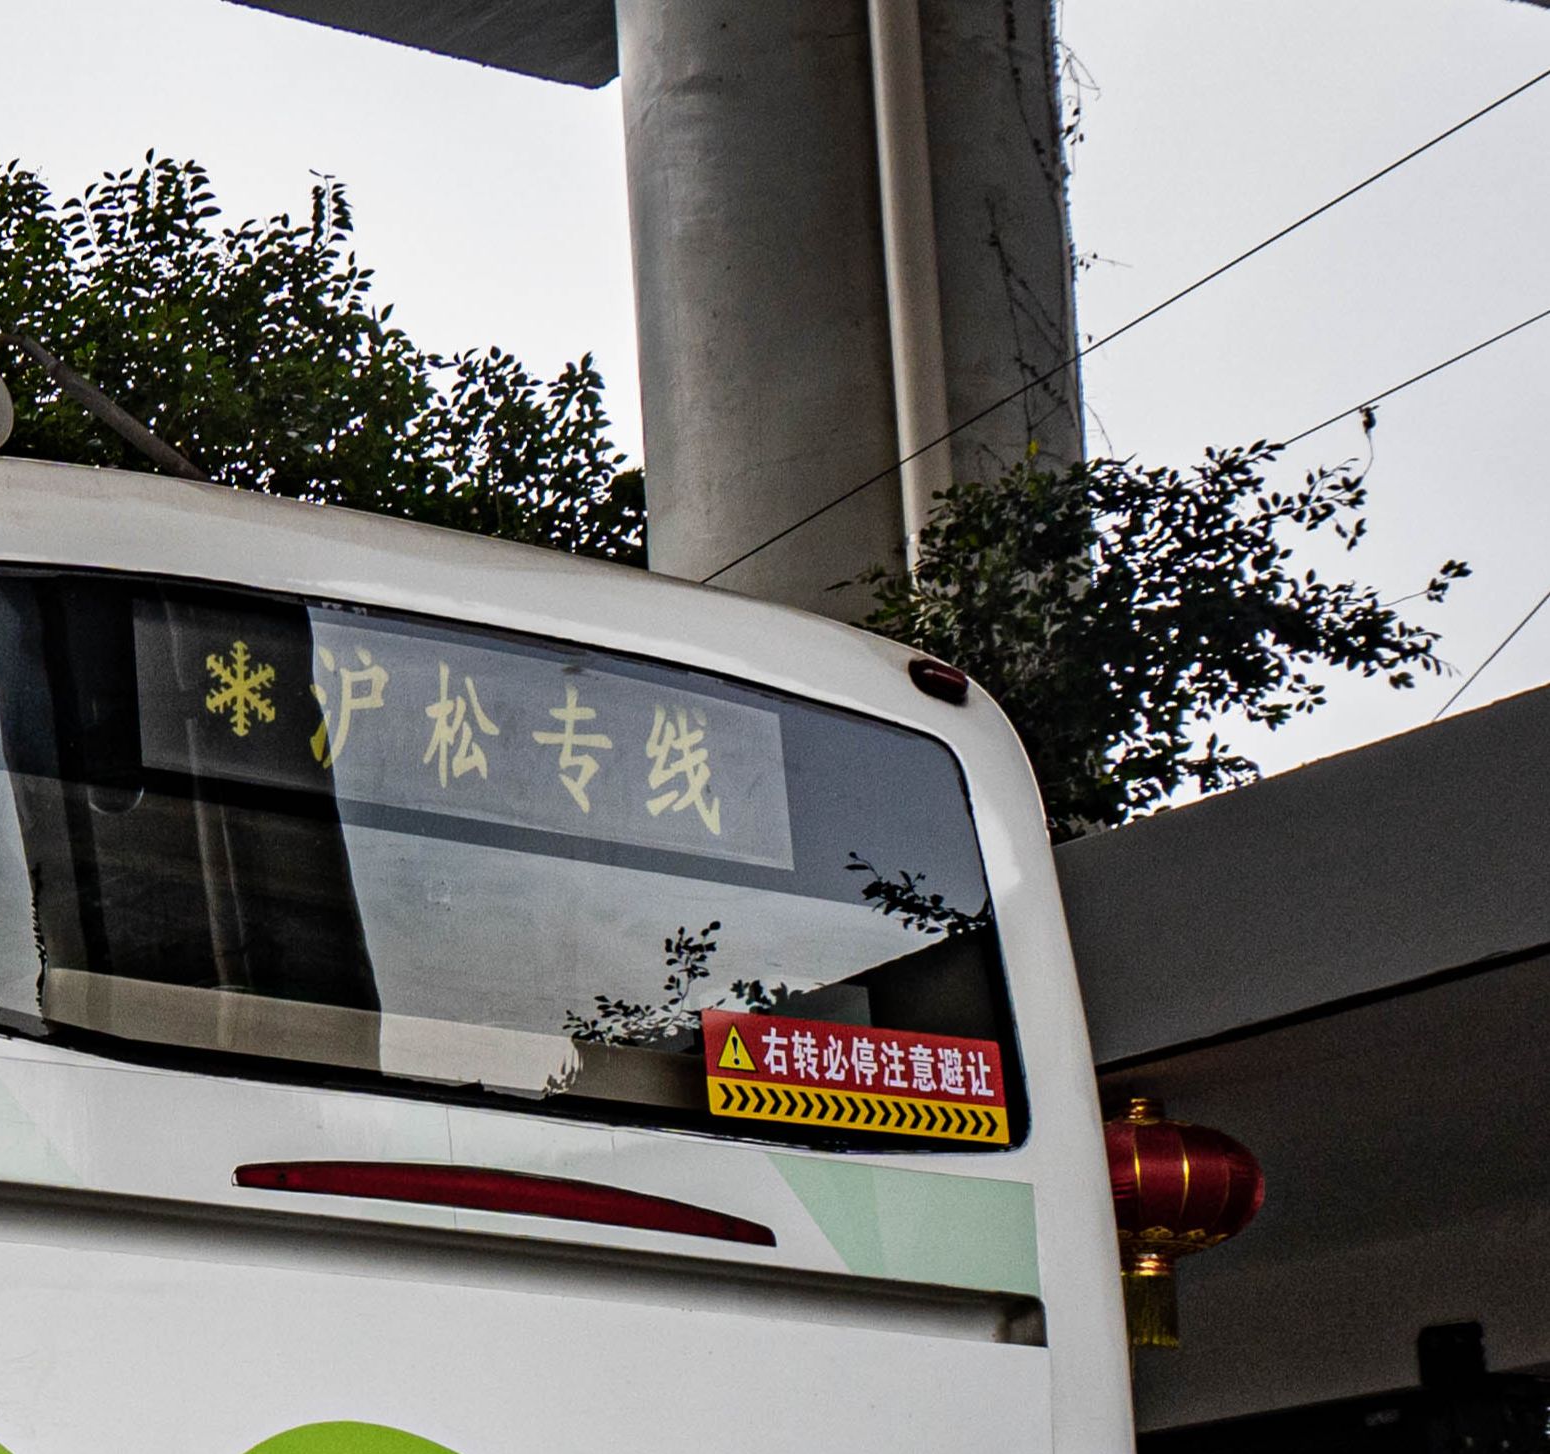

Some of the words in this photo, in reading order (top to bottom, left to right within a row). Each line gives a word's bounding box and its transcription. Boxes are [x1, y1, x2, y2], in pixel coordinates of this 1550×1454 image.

[308, 643, 723, 837] 沪松专线
[760, 1026, 995, 1097] 右转必停注意避让
